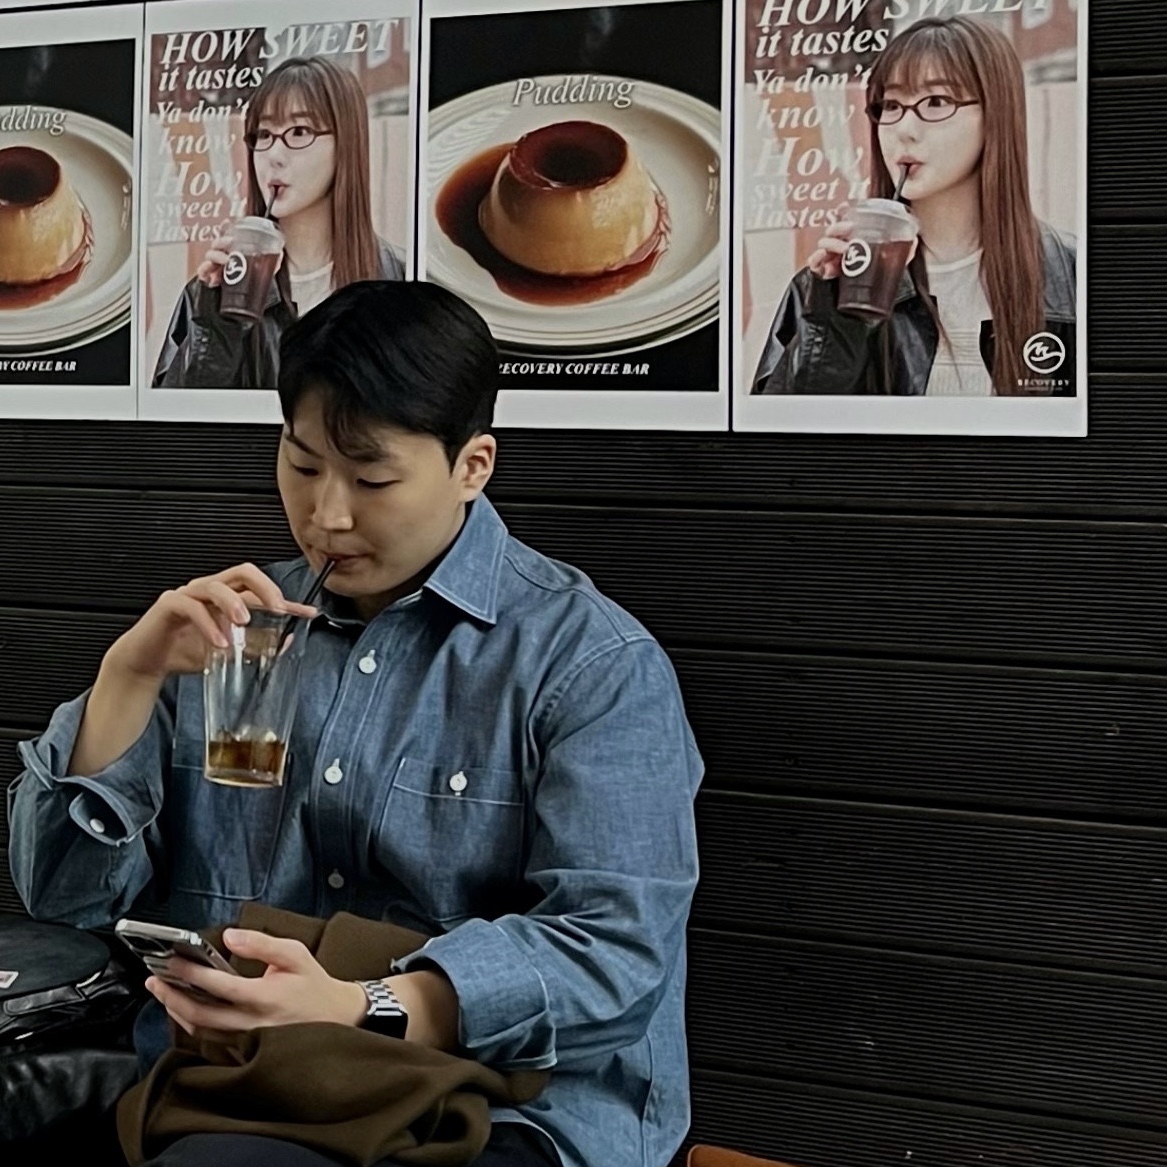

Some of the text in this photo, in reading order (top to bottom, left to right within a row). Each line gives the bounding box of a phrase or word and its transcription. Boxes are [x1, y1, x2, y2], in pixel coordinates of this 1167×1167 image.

[756, 0, 870, 27] HOW
[159, 18, 400, 66] HOW SWEET
[756, 26, 889, 58] it tastes
[158, 62, 264, 92] it tastes
[512, 74, 634, 108] Pudding
[753, 65, 872, 94] Ya don't
[157, 97, 250, 125] Ya don't
[756, 99, 855, 130] know
[157, 128, 236, 156] know
[754, 136, 864, 177] How
[154, 161, 243, 197] How
[755, 178, 840, 202] sweet
[155, 197, 224, 219] sweet
[11, 360, 54, 372] COFFEE
[55, 360, 77, 372] BAR
[565, 363, 620, 375] COFFEE
[622, 363, 650, 375] BAR
